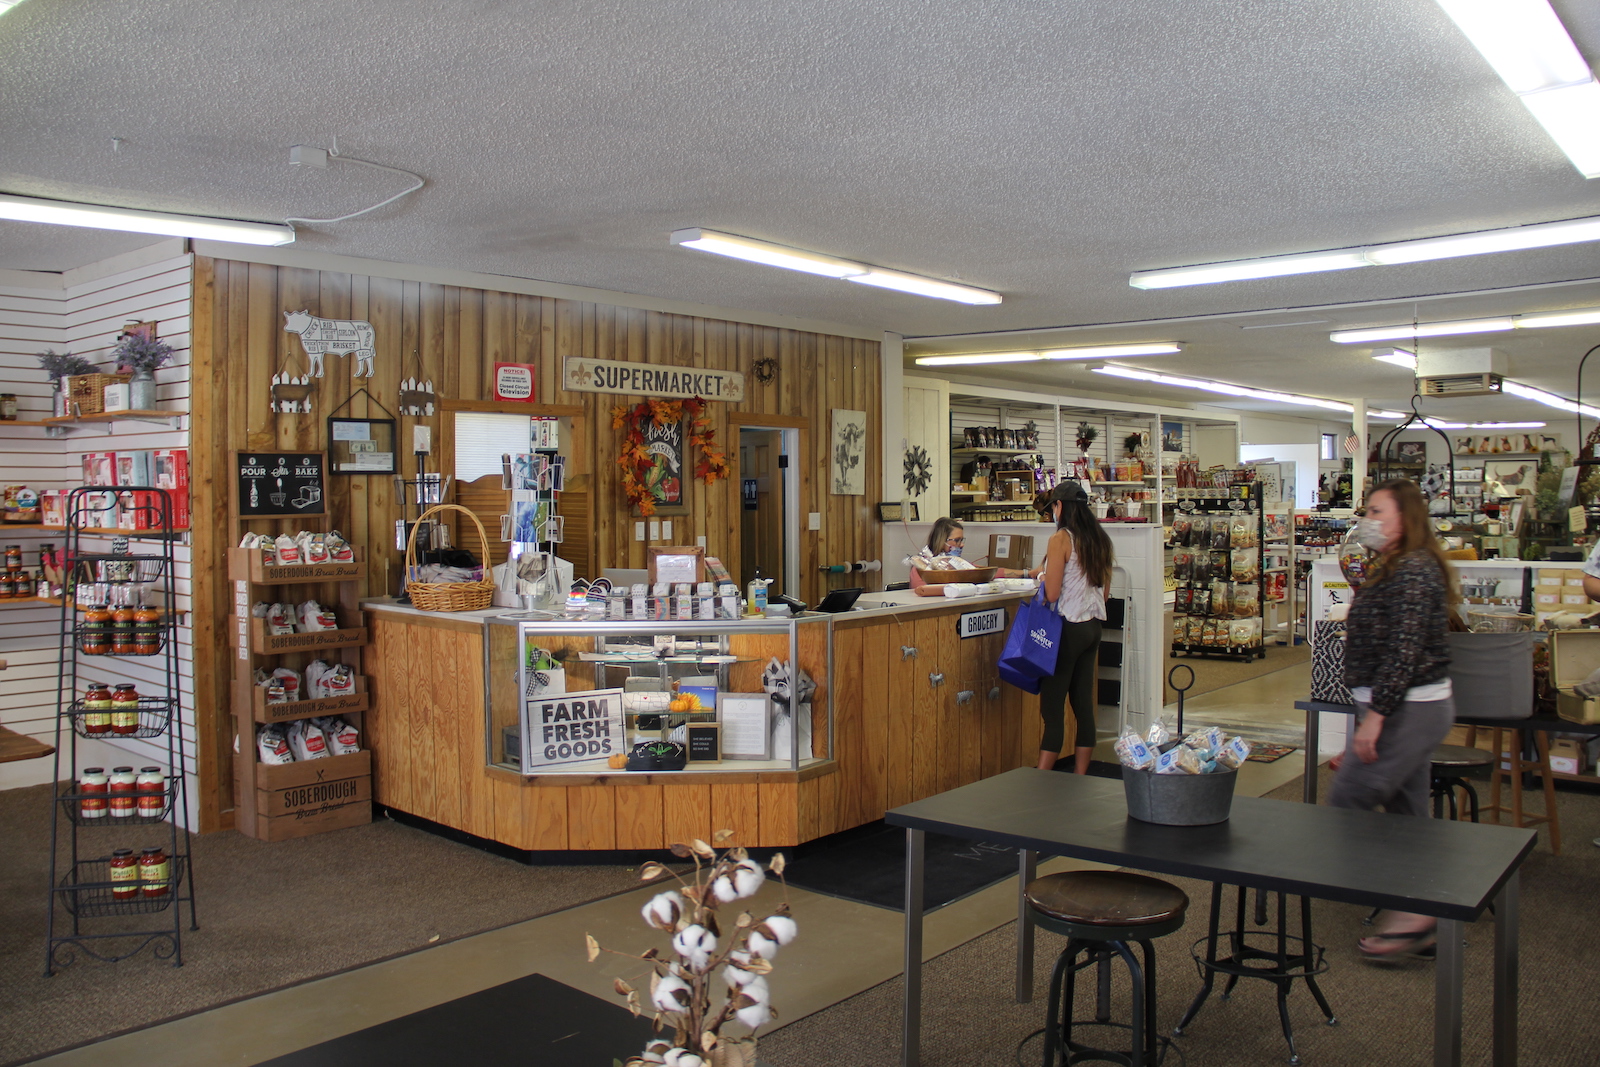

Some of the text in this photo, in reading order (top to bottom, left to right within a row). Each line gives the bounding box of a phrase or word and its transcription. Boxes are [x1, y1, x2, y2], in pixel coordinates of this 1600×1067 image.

[304, 321, 319, 339] CHUCK
[593, 365, 724, 396] SUPERMARKET
[651, 444, 676, 460] MARKET
[240, 468, 266, 476] POUR
[295, 467, 318, 476] BAKE
[269, 566, 359, 579] SOBERDOUGH Brew Bread
[968, 613, 999, 633] GROCERY
[271, 633, 361, 649] SOBERDOUGH Brew Bread
[272, 699, 361, 718] SOBERDOUGH Brew Bread
[541, 698, 609, 724] FARM
[542, 719, 610, 744] FRESH
[543, 738, 612, 760] GOODS
[284, 780, 357, 809] SOBERDOUGH
[295, 808, 319, 820] Brew
[320, 799, 346, 813] Bread
